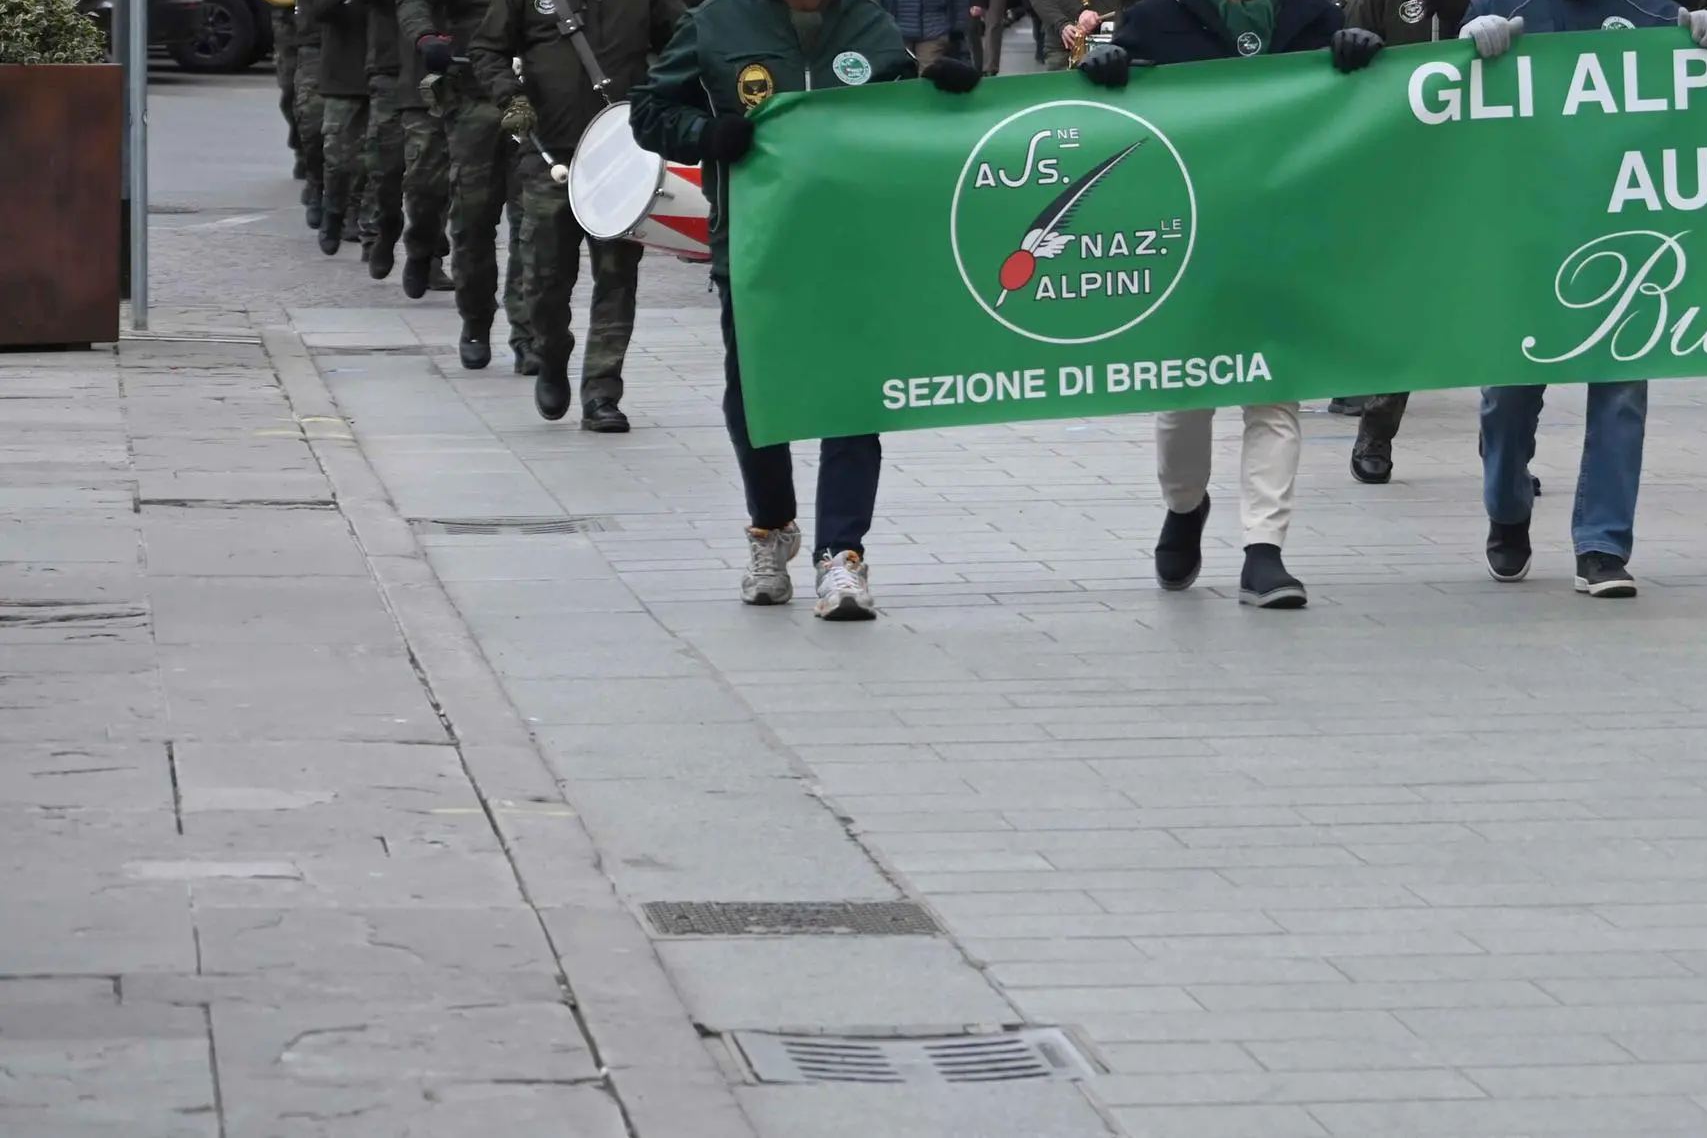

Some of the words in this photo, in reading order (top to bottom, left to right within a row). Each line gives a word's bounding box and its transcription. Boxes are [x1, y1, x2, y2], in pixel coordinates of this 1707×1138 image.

[1407, 56, 1534, 125] GLI
[1034, 268, 1152, 301] ALPINI
[882, 368, 1047, 409] SEZIONE
[1059, 365, 1094, 396] DI
[1106, 352, 1272, 393] BRESCIA
